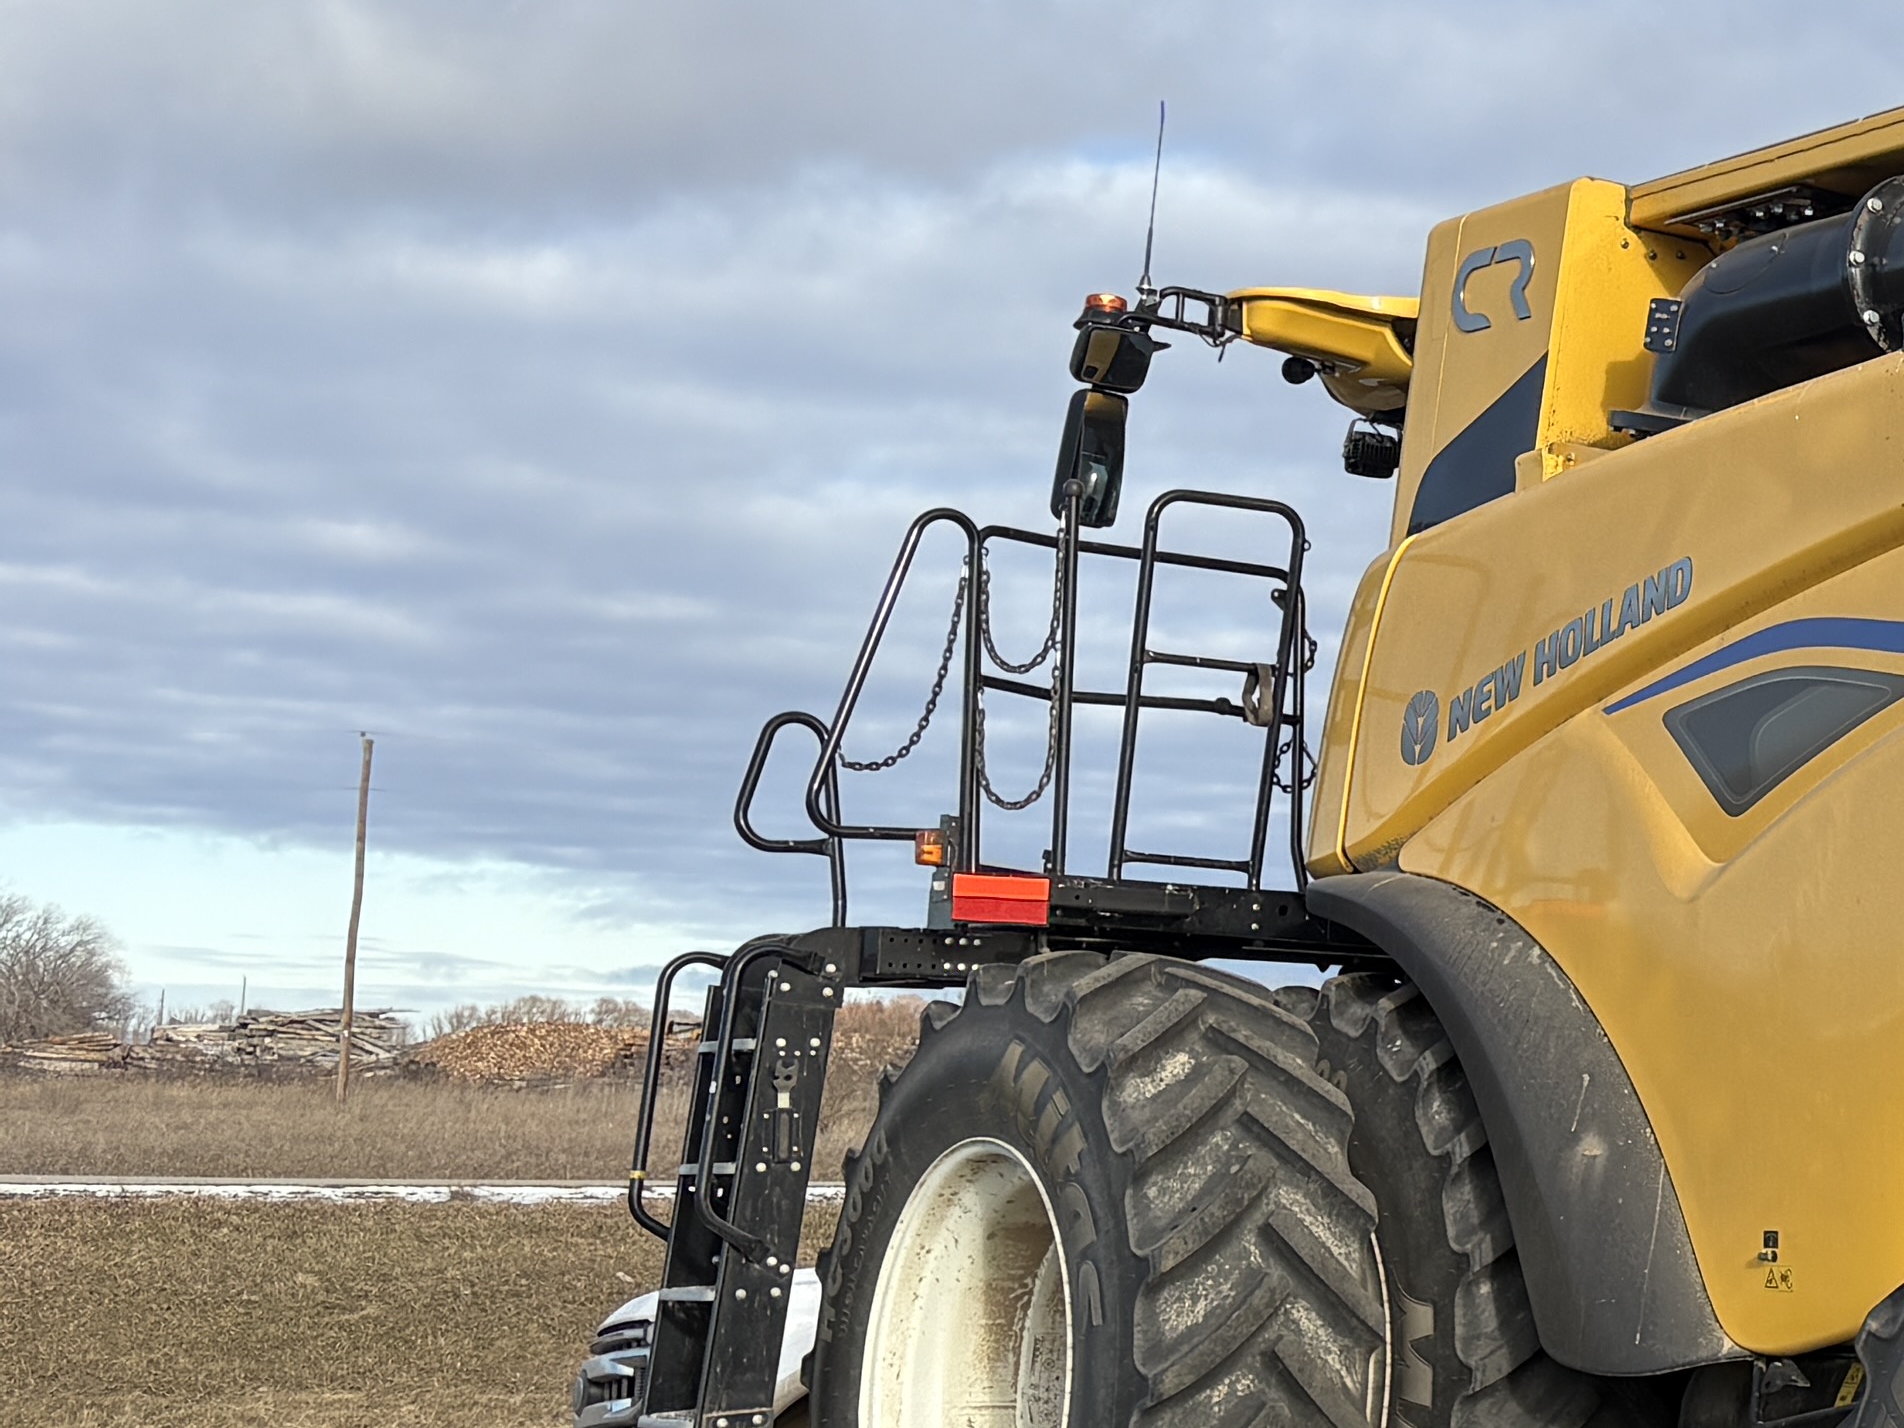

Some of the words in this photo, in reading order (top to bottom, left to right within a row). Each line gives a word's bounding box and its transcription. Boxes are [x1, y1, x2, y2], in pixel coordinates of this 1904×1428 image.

[1451, 237, 1536, 334] CR
[1446, 650, 1527, 744] NEW
[1532, 554, 1694, 688] HOLLAND
